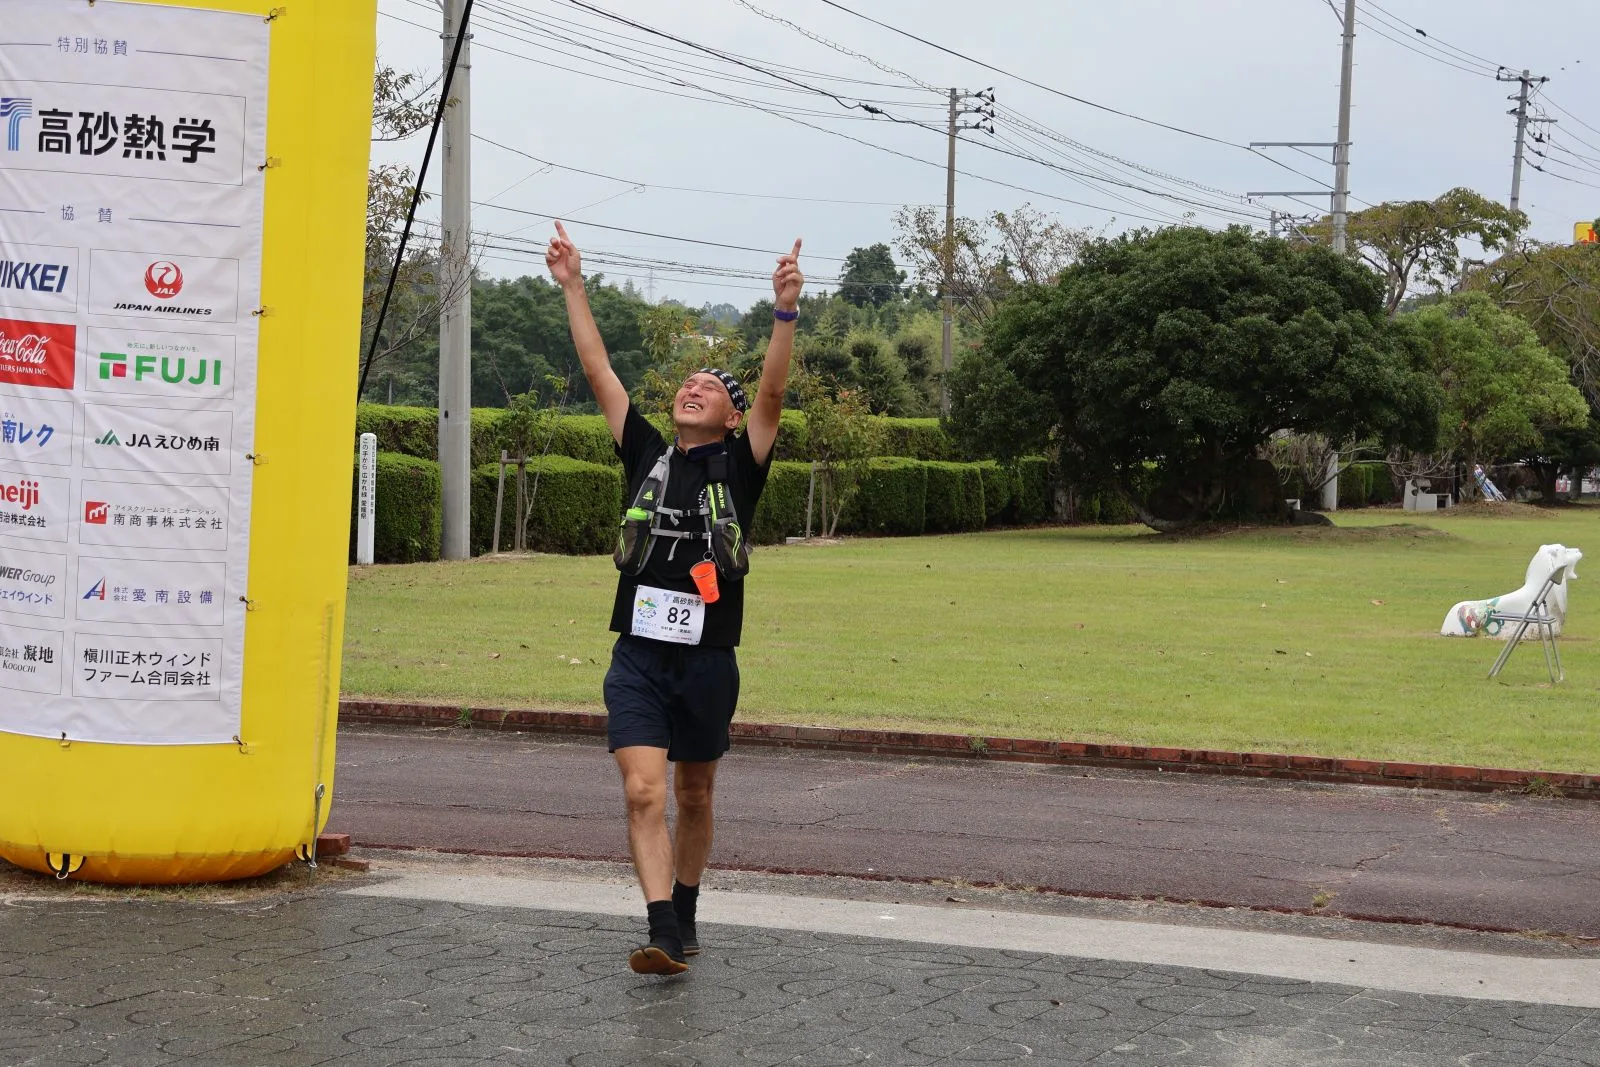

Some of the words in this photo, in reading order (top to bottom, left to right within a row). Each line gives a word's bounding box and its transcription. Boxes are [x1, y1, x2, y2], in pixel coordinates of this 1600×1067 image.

[57, 36, 128, 56] 特別協賛
[38, 108, 216, 163] 高砂熱学
[154, 287, 176, 295] JAL
[113, 303, 152, 312] JAPAN
[155, 305, 212, 315] AIRLINES
[16, 366, 34, 374] JAPAN
[135, 355, 222, 385] FUJI
[125, 434, 220, 452] JAえひめ南
[114, 504, 217, 515] アイスクリームコミュニケーション
[113, 513, 223, 530] 南商事株式会社
[23, 569, 56, 587] Group
[132, 588, 213, 604] 愛南設備
[667, 607, 691, 626] 82
[83, 667, 212, 686] ファーム合同会社
